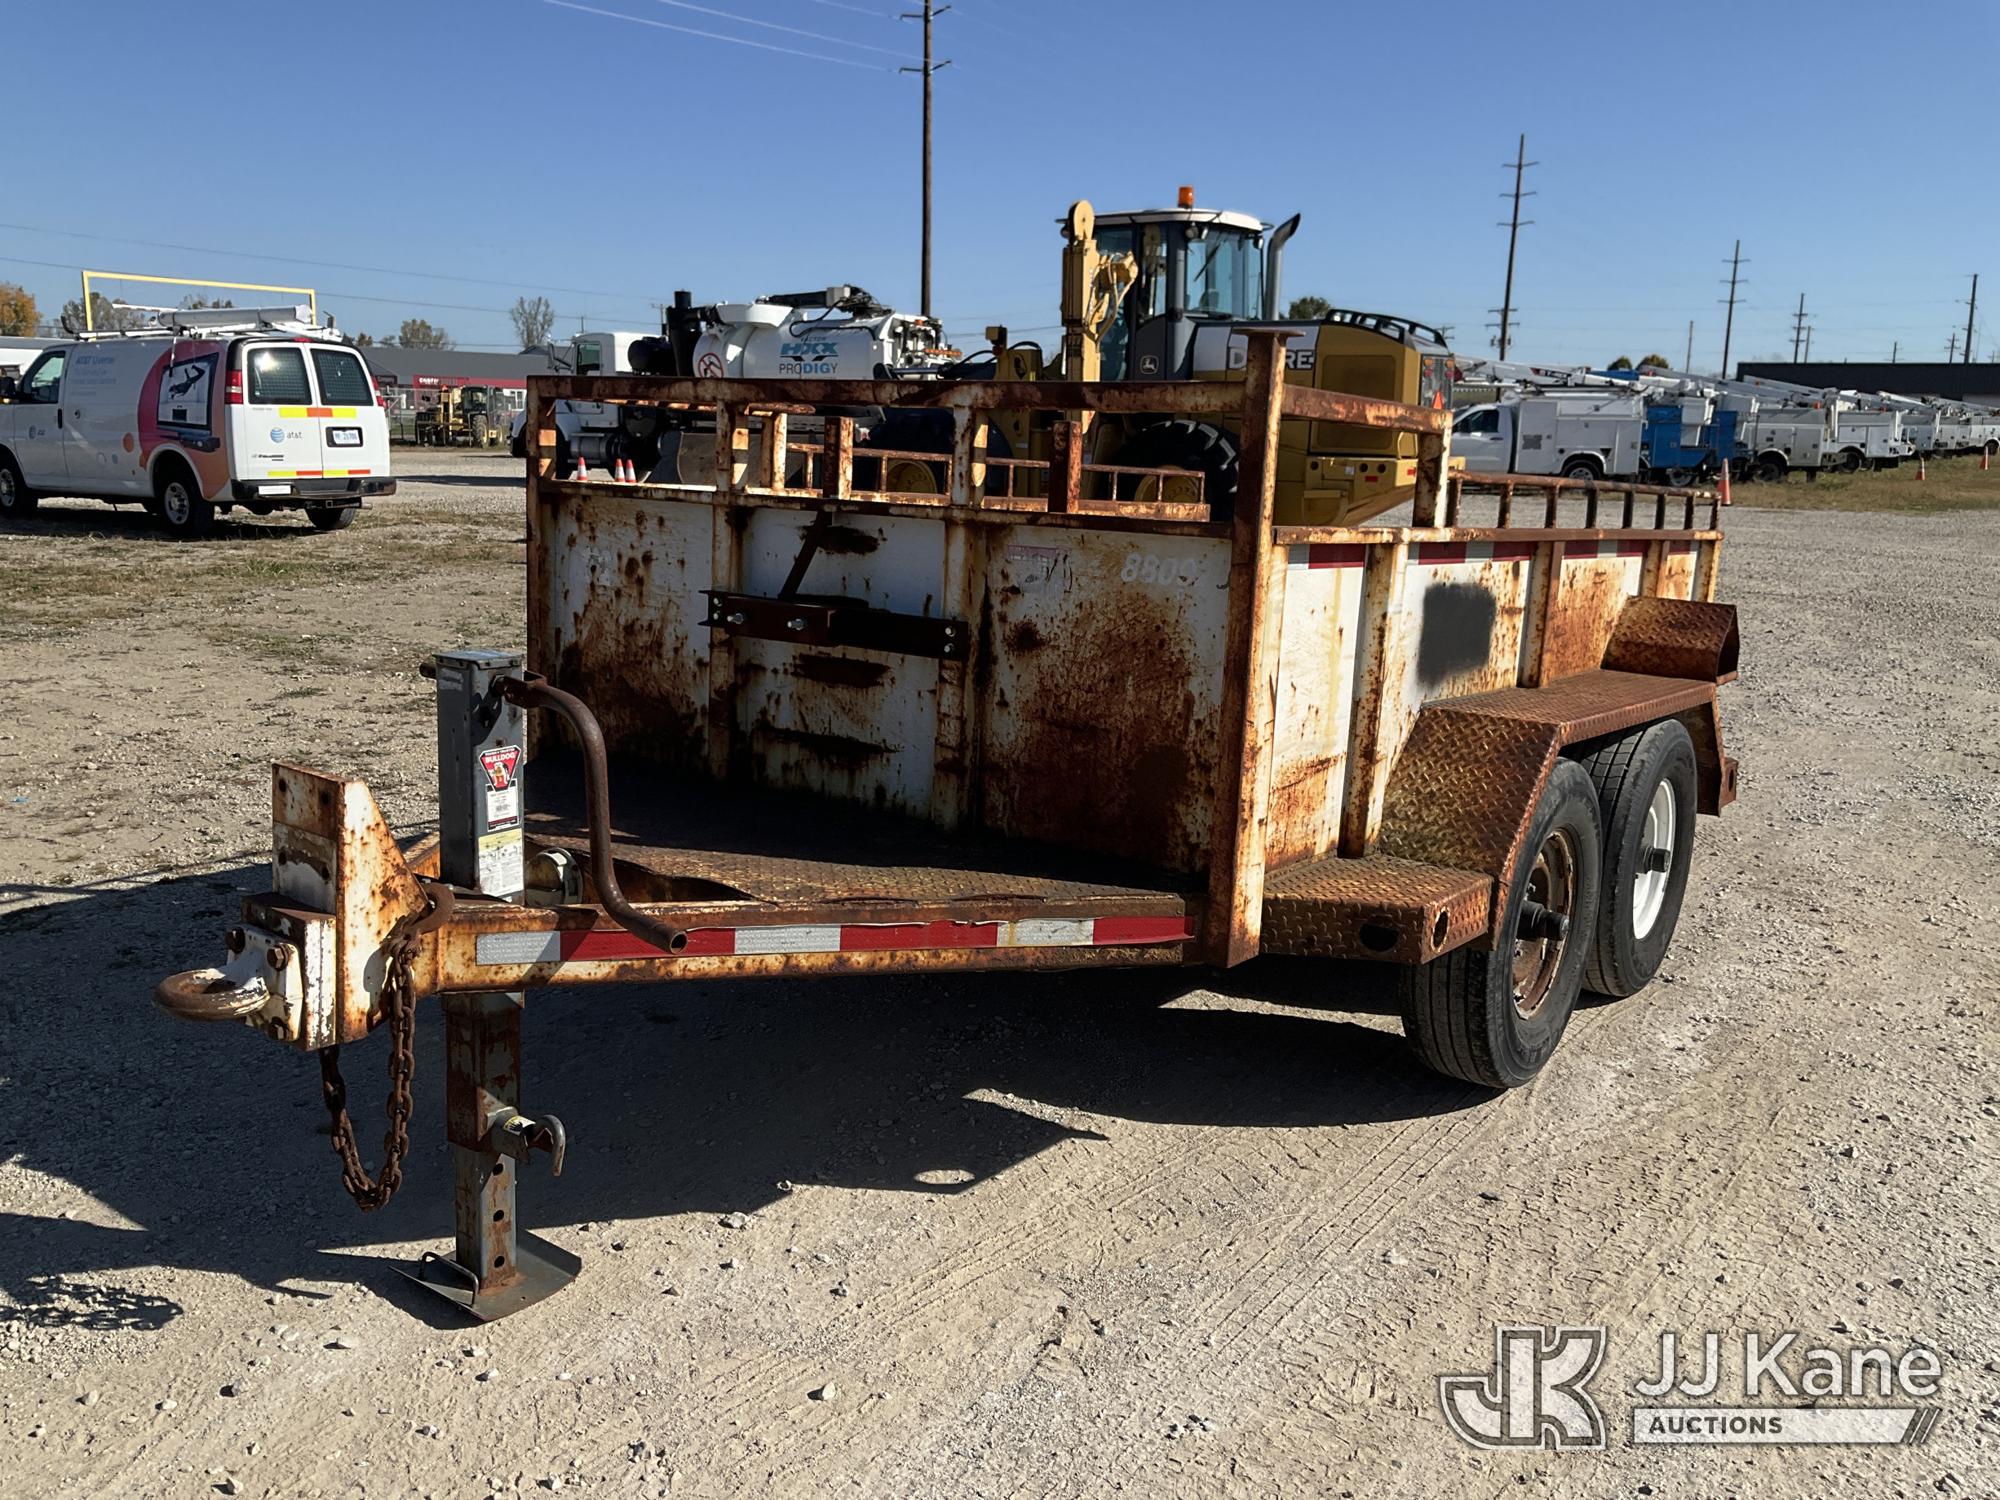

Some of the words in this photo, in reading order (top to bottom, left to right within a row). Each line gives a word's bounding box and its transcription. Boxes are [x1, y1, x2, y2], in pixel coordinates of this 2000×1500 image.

[1229, 349, 1313, 370] DRE
[779, 363, 838, 375] PRODIGY
[485, 752, 515, 764] BULLDOG
